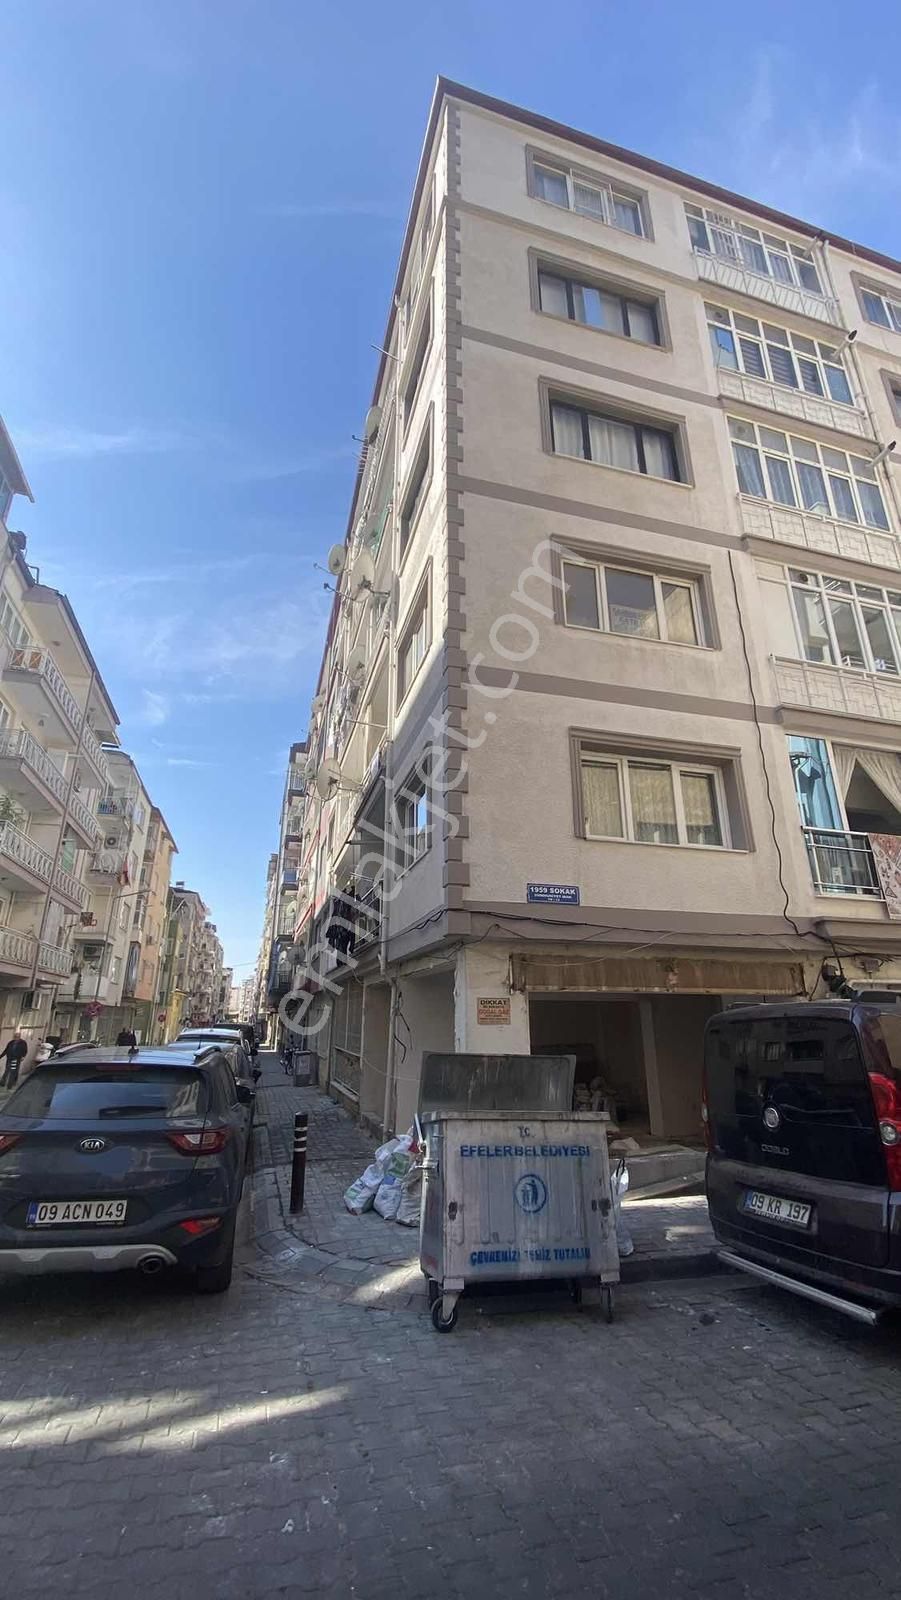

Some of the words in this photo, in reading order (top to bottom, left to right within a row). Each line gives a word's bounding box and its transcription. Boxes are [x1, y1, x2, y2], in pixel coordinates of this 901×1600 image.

[530, 886, 548, 894] 1959
[549, 887, 576, 895] SOKAK
[83, 1141, 101, 1150] KIA
[39, 1205, 58, 1221] 09
[62, 1204, 92, 1219] ACN
[95, 1202, 124, 1219] 049
[752, 1194, 764, 1208] 09
[767, 1198, 782, 1214] KR
[787, 1203, 809, 1220] 197
